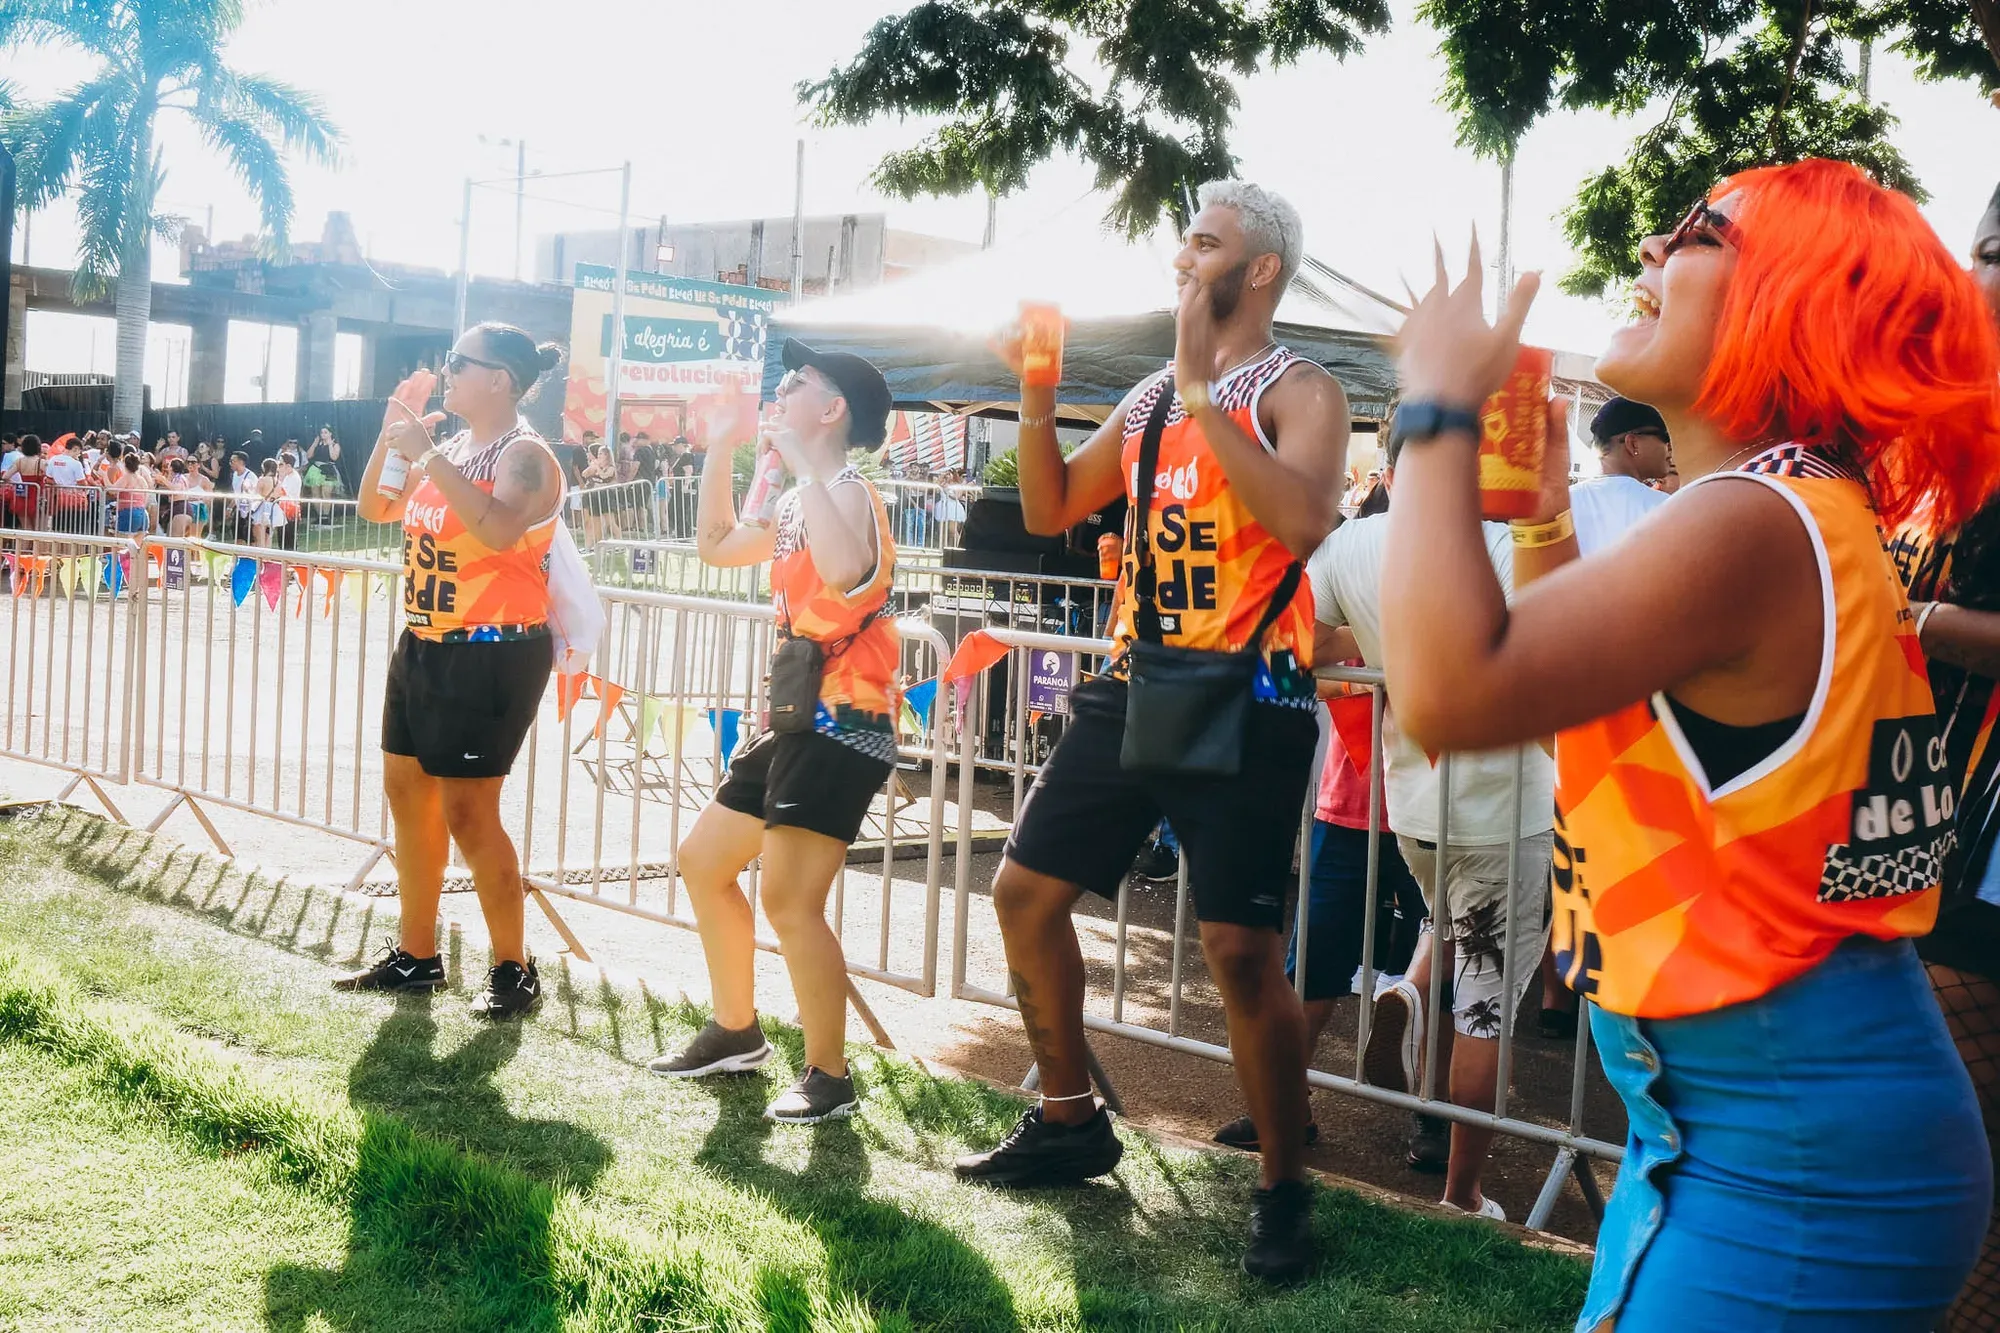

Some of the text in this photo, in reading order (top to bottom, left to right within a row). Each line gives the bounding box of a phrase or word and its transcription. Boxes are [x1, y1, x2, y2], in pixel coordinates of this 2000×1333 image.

[634, 326, 694, 358] alegria
[697, 329, 711, 352] é
[1157, 504, 1217, 553] SE
[416, 532, 458, 572] SE
[1033, 675, 1070, 688] PARANOÁ
[1855, 794, 1915, 841] de
